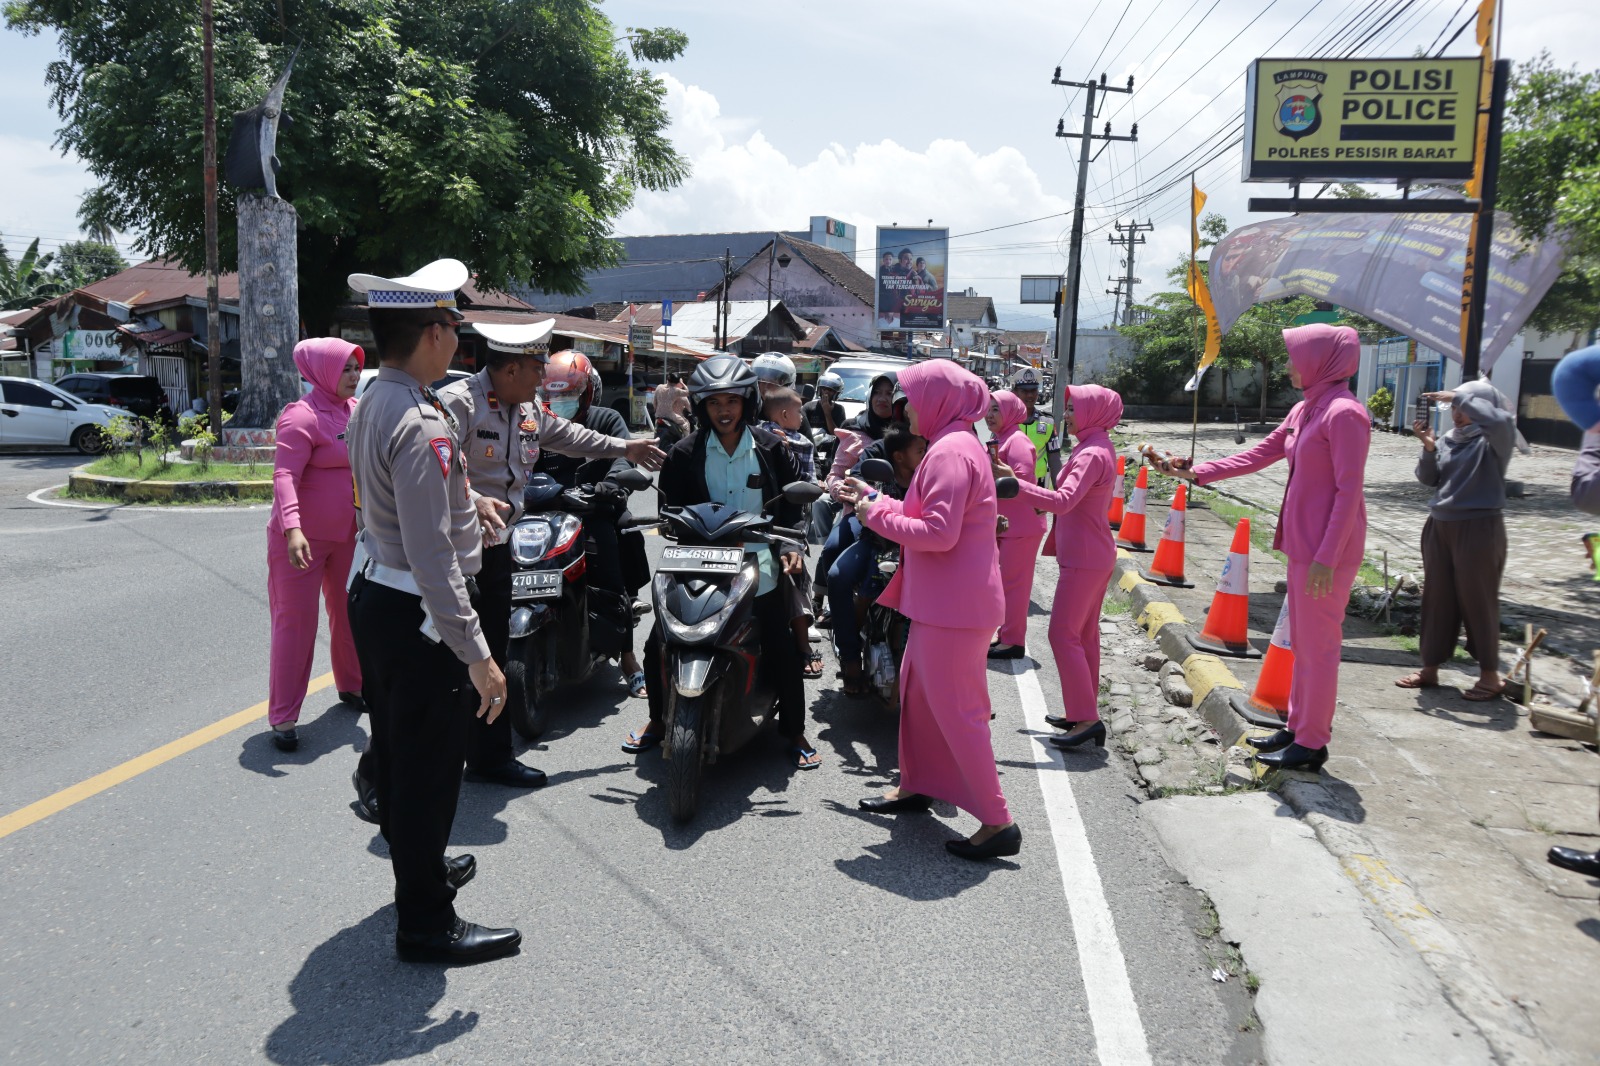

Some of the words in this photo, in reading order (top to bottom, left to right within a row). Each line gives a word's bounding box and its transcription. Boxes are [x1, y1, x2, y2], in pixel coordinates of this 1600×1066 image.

[1276, 72, 1325, 82] LAMPUNG
[1350, 69, 1454, 91] POLISI
[1342, 99, 1457, 120] POLICE
[1268, 147, 1330, 159] POLRES
[1335, 147, 1399, 159] PESISIR
[1403, 148, 1458, 159] BARAT
[1461, 247, 1474, 312] BARAT
[904, 295, 943, 311] Surya
[519, 433, 540, 444] POLR
[512, 575, 537, 587] 4701
[542, 574, 556, 585] XF
